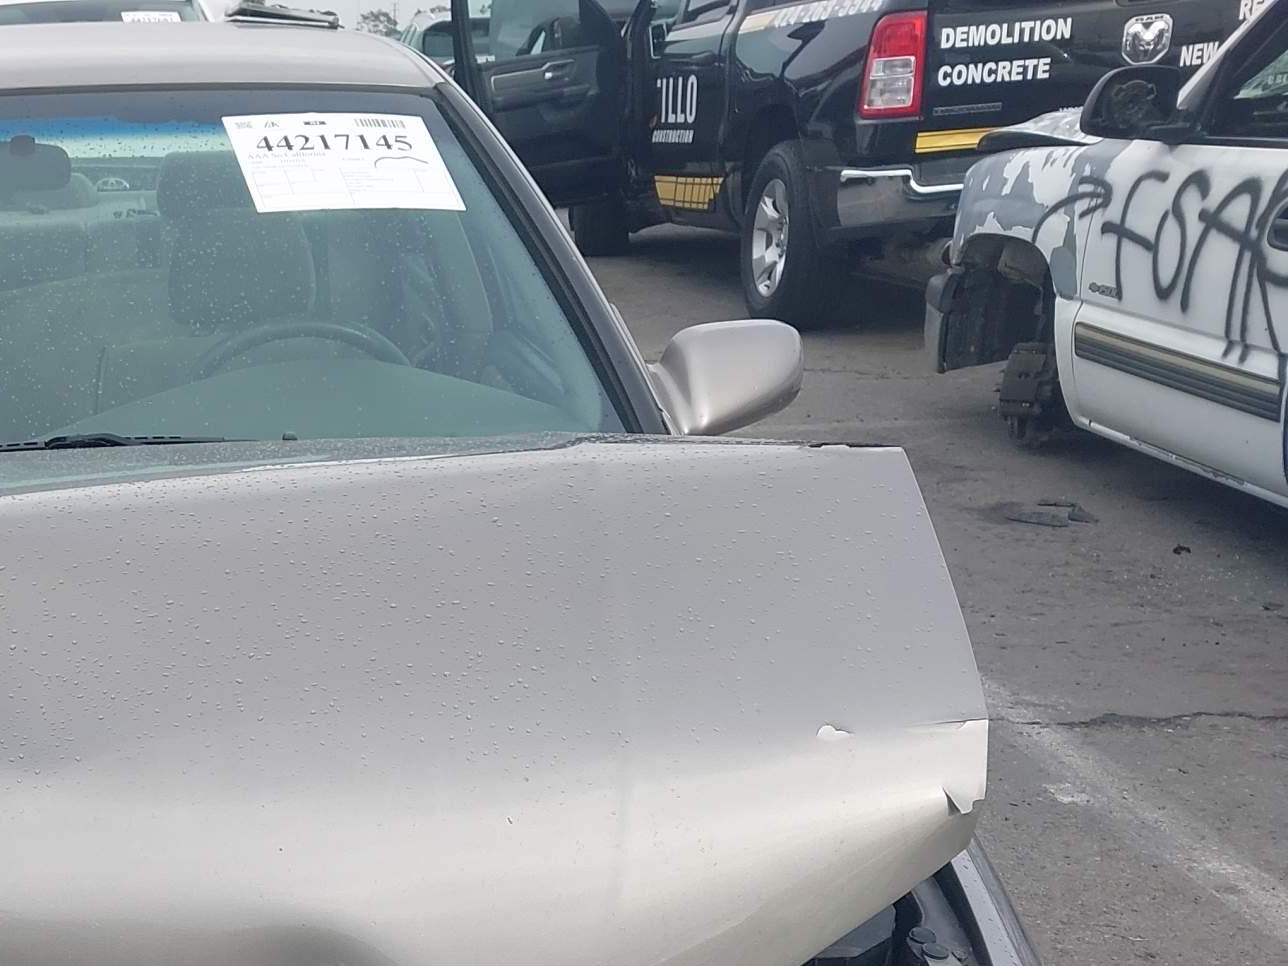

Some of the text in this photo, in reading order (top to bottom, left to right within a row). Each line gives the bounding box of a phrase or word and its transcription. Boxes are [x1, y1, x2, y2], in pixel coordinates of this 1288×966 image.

[941, 17, 1072, 48] DEMOLITION
[938, 58, 1051, 86] CONCRETE
[656, 74, 698, 123] ILLO
[256, 134, 412, 152] 44217145
